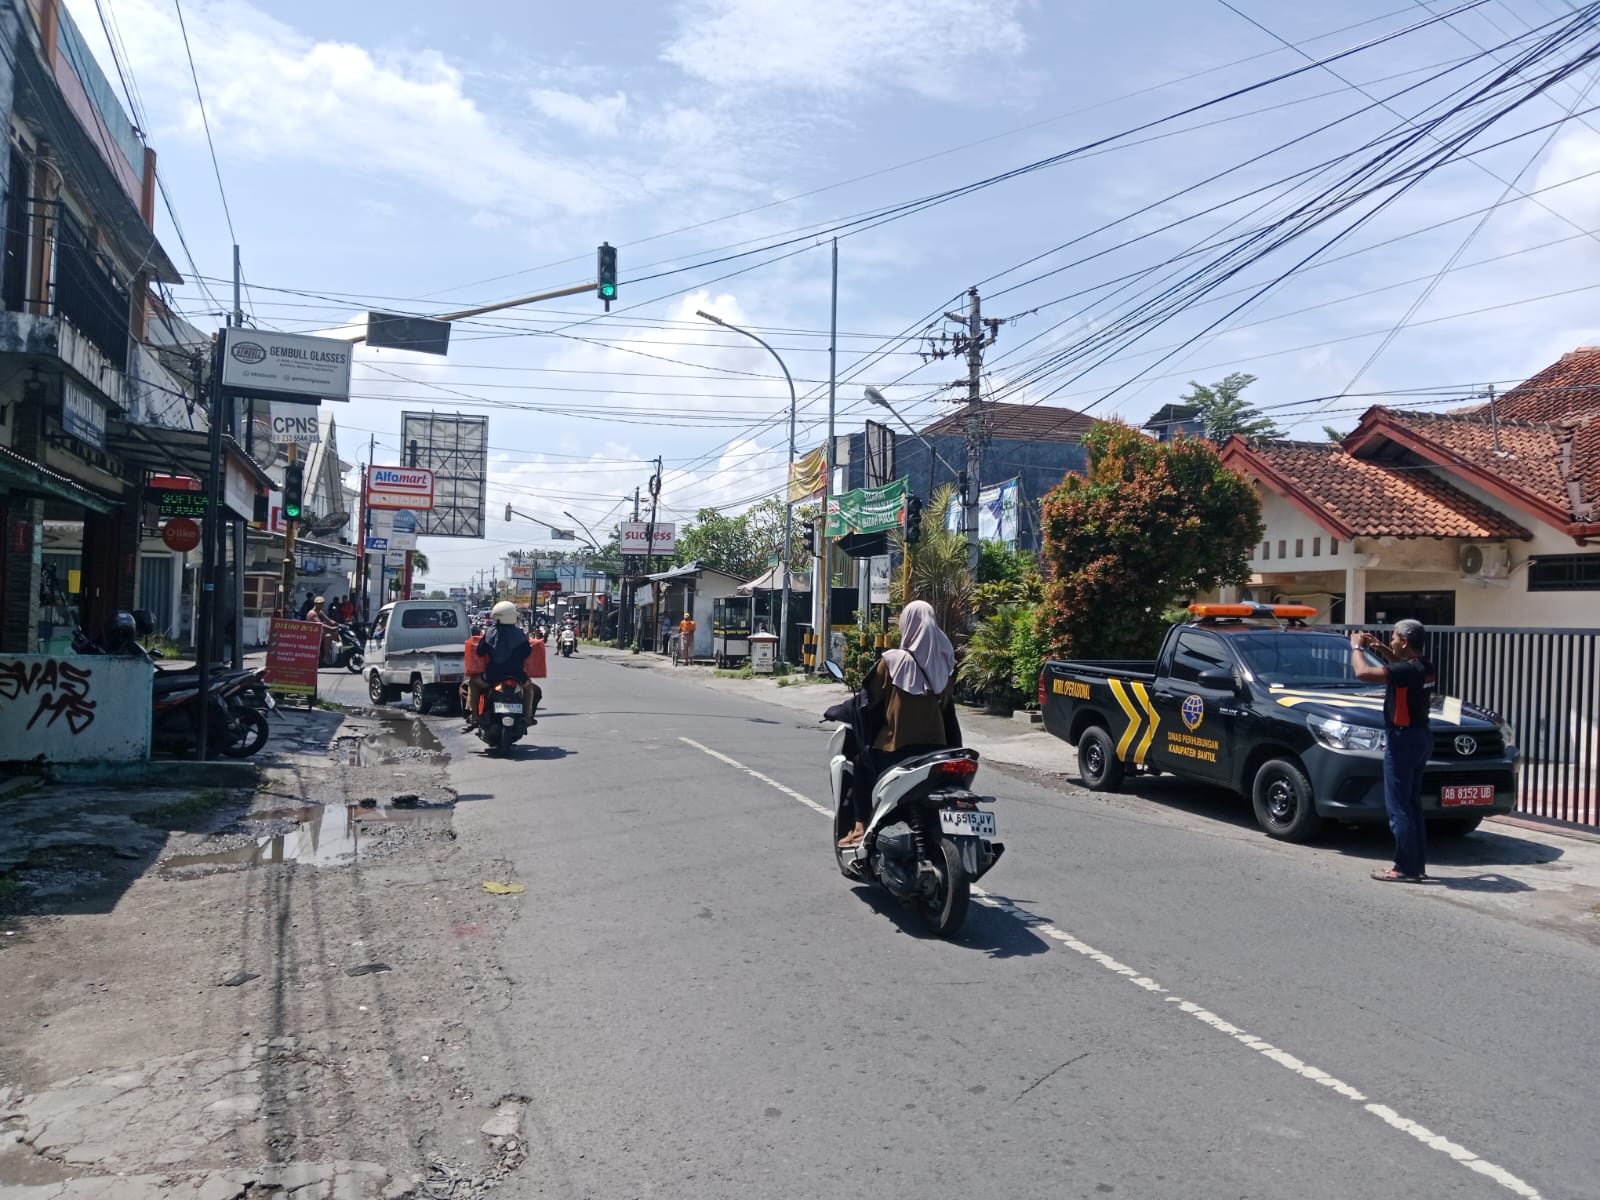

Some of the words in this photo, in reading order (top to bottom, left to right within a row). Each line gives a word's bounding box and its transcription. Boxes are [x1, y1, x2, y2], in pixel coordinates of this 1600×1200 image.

[270, 345, 308, 360] GEMBULL
[310, 350, 346, 364] GLASSES
[273, 416, 319, 433] CPNS
[375, 471, 428, 485] Alfamart
[625, 531, 672, 540] sucess
[1167, 731, 1182, 742] DINAS
[1168, 744, 1197, 758] KABUPATEN
[1197, 750, 1216, 763] BANTUL
[1445, 788, 1455, 799] AB
[1457, 787, 1478, 799] 8152
[1480, 787, 1491, 799] UB
[943, 813, 953, 823] AA
[979, 815, 991, 825] UV
